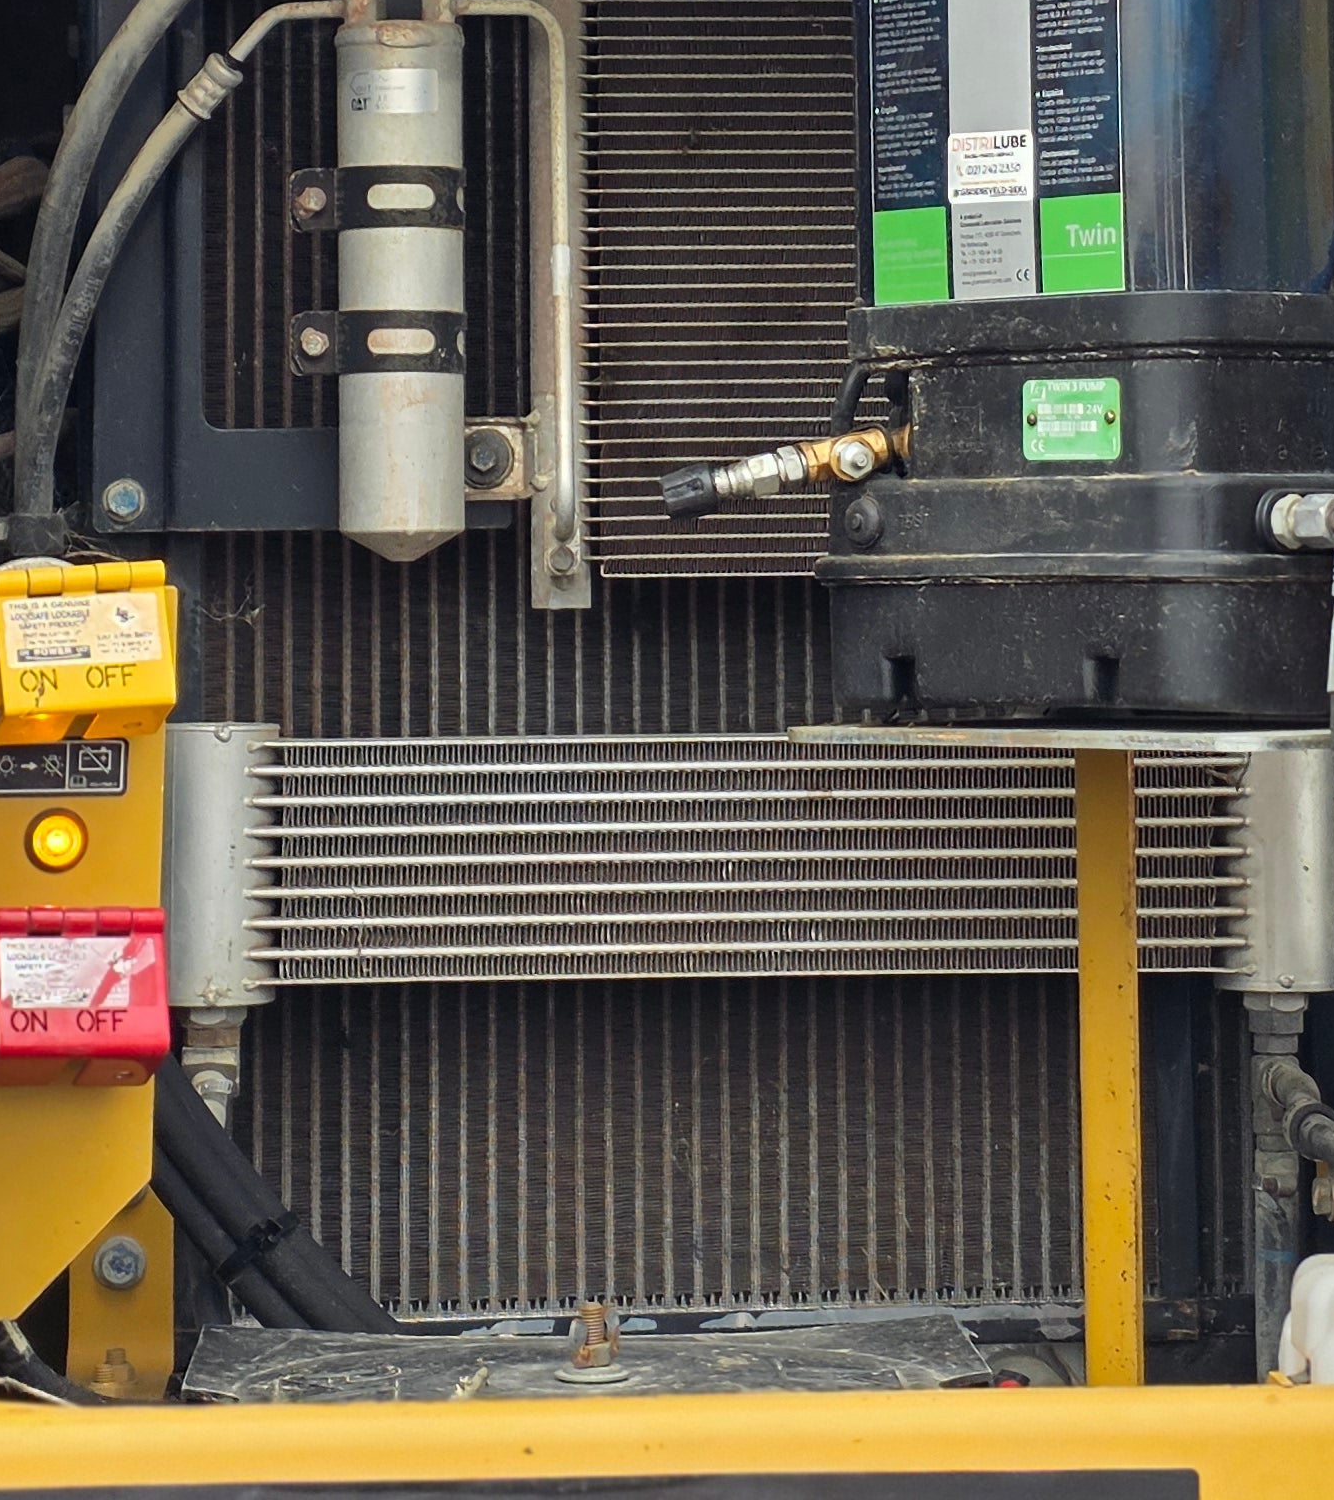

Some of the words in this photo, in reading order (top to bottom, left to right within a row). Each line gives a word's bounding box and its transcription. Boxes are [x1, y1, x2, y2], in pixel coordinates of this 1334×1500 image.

[952, 134, 1027, 152] DISTRILUBE
[1065, 222, 1116, 248] Twin
[1079, 381, 1107, 392] PUMP
[1086, 404, 1104, 415] 24V
[19, 668, 59, 693] ON
[85, 663, 137, 689] OFF
[10, 1009, 49, 1033] ON
[76, 1009, 128, 1033] OFF
